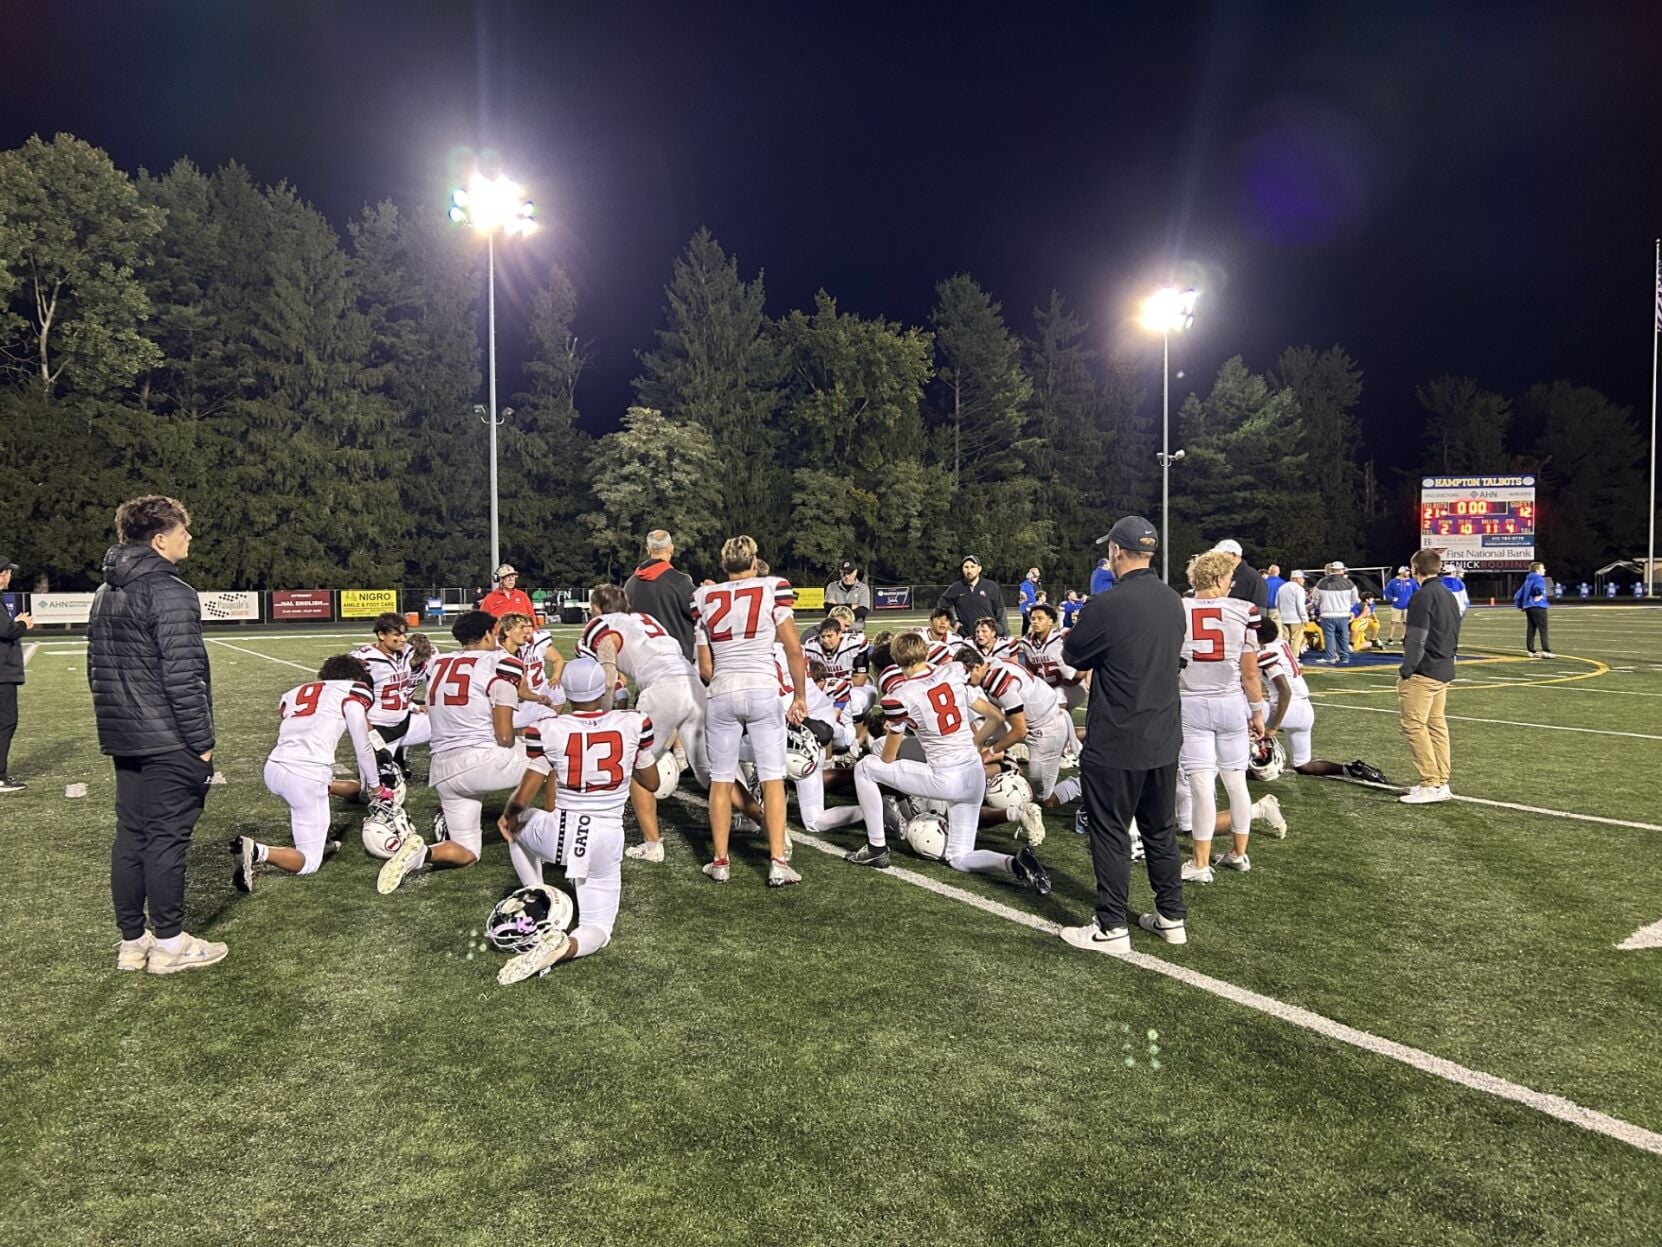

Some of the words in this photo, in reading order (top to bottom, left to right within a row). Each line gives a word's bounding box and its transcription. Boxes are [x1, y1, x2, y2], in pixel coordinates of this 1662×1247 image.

[1435, 478, 1480, 487] HAMPTON
[1482, 477, 1522, 487] TALBOTS
[1480, 491, 1498, 499] AHN
[1424, 508, 1440, 518] 21
[1519, 507, 1532, 518] 12
[1441, 524, 1450, 534] 2
[1460, 524, 1473, 534] 10
[1486, 524, 1498, 534] 11
[1506, 524, 1515, 534] 4
[1447, 550, 1464, 558] First
[1466, 549, 1506, 558] National
[1508, 548, 1532, 558] Bank
[705, 587, 765, 642] 27
[1192, 608, 1225, 662] 5
[428, 656, 478, 707] 75
[292, 682, 325, 718] 9
[927, 682, 962, 736] 8
[565, 730, 625, 794] 13
[574, 814, 592, 858] GATO
